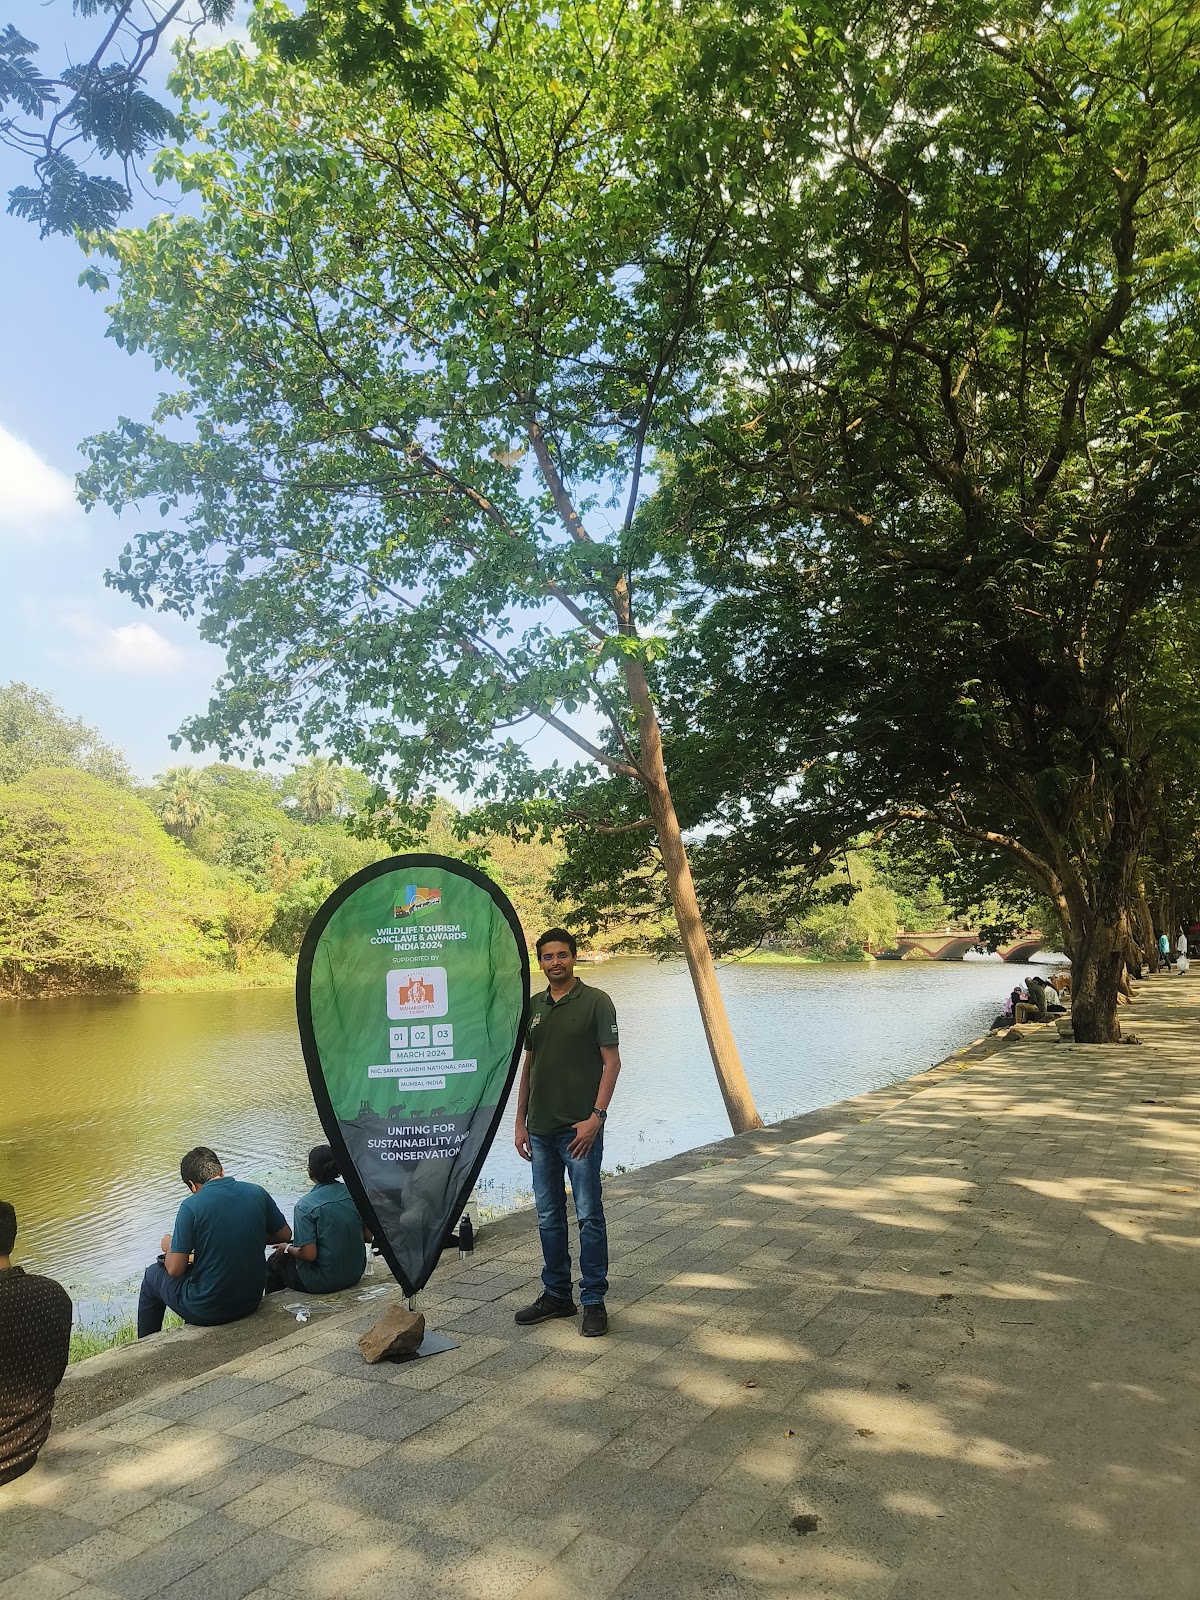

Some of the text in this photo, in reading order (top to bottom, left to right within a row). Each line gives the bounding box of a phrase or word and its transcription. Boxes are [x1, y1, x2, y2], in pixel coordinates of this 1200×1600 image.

[376, 924, 460, 936] WILDLIFE TOURISM
[370, 934, 418, 944] CONCLAVE
[426, 932, 467, 941] AWARDS
[394, 941, 443, 951] INDIA 2024
[392, 956, 430, 964] SUPPORTED
[415, 1032, 426, 1040] 02
[387, 1123, 456, 1136] UNITING FOR
[367, 1136, 452, 1148] SUSTAINABILITY
